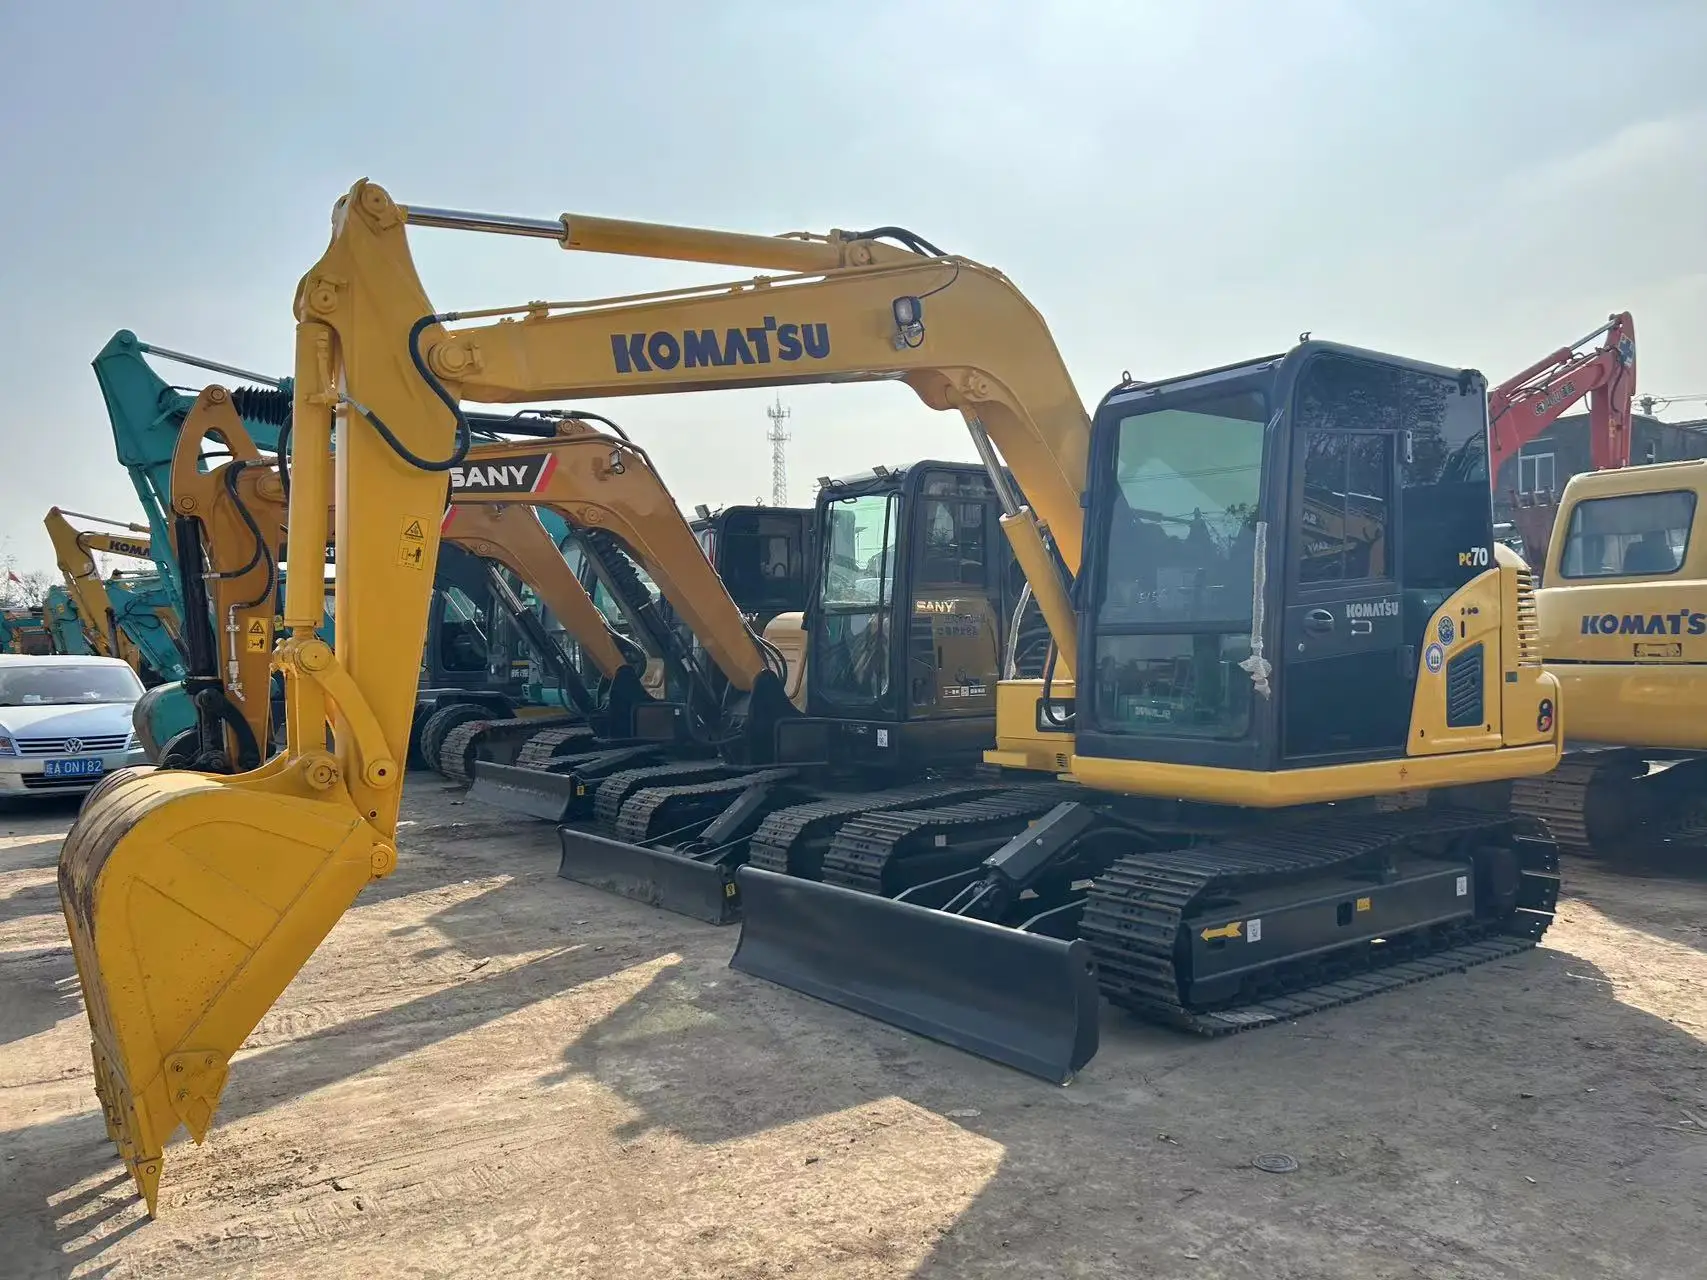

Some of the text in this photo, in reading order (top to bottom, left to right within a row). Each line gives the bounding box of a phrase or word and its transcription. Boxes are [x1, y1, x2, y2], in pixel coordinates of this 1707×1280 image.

[610, 316, 831, 373] KOMATSU
[449, 465, 528, 488] SANY
[1458, 547, 1489, 566] PC70
[916, 600, 954, 613] SANY
[1346, 598, 1399, 618] KOMATSU
